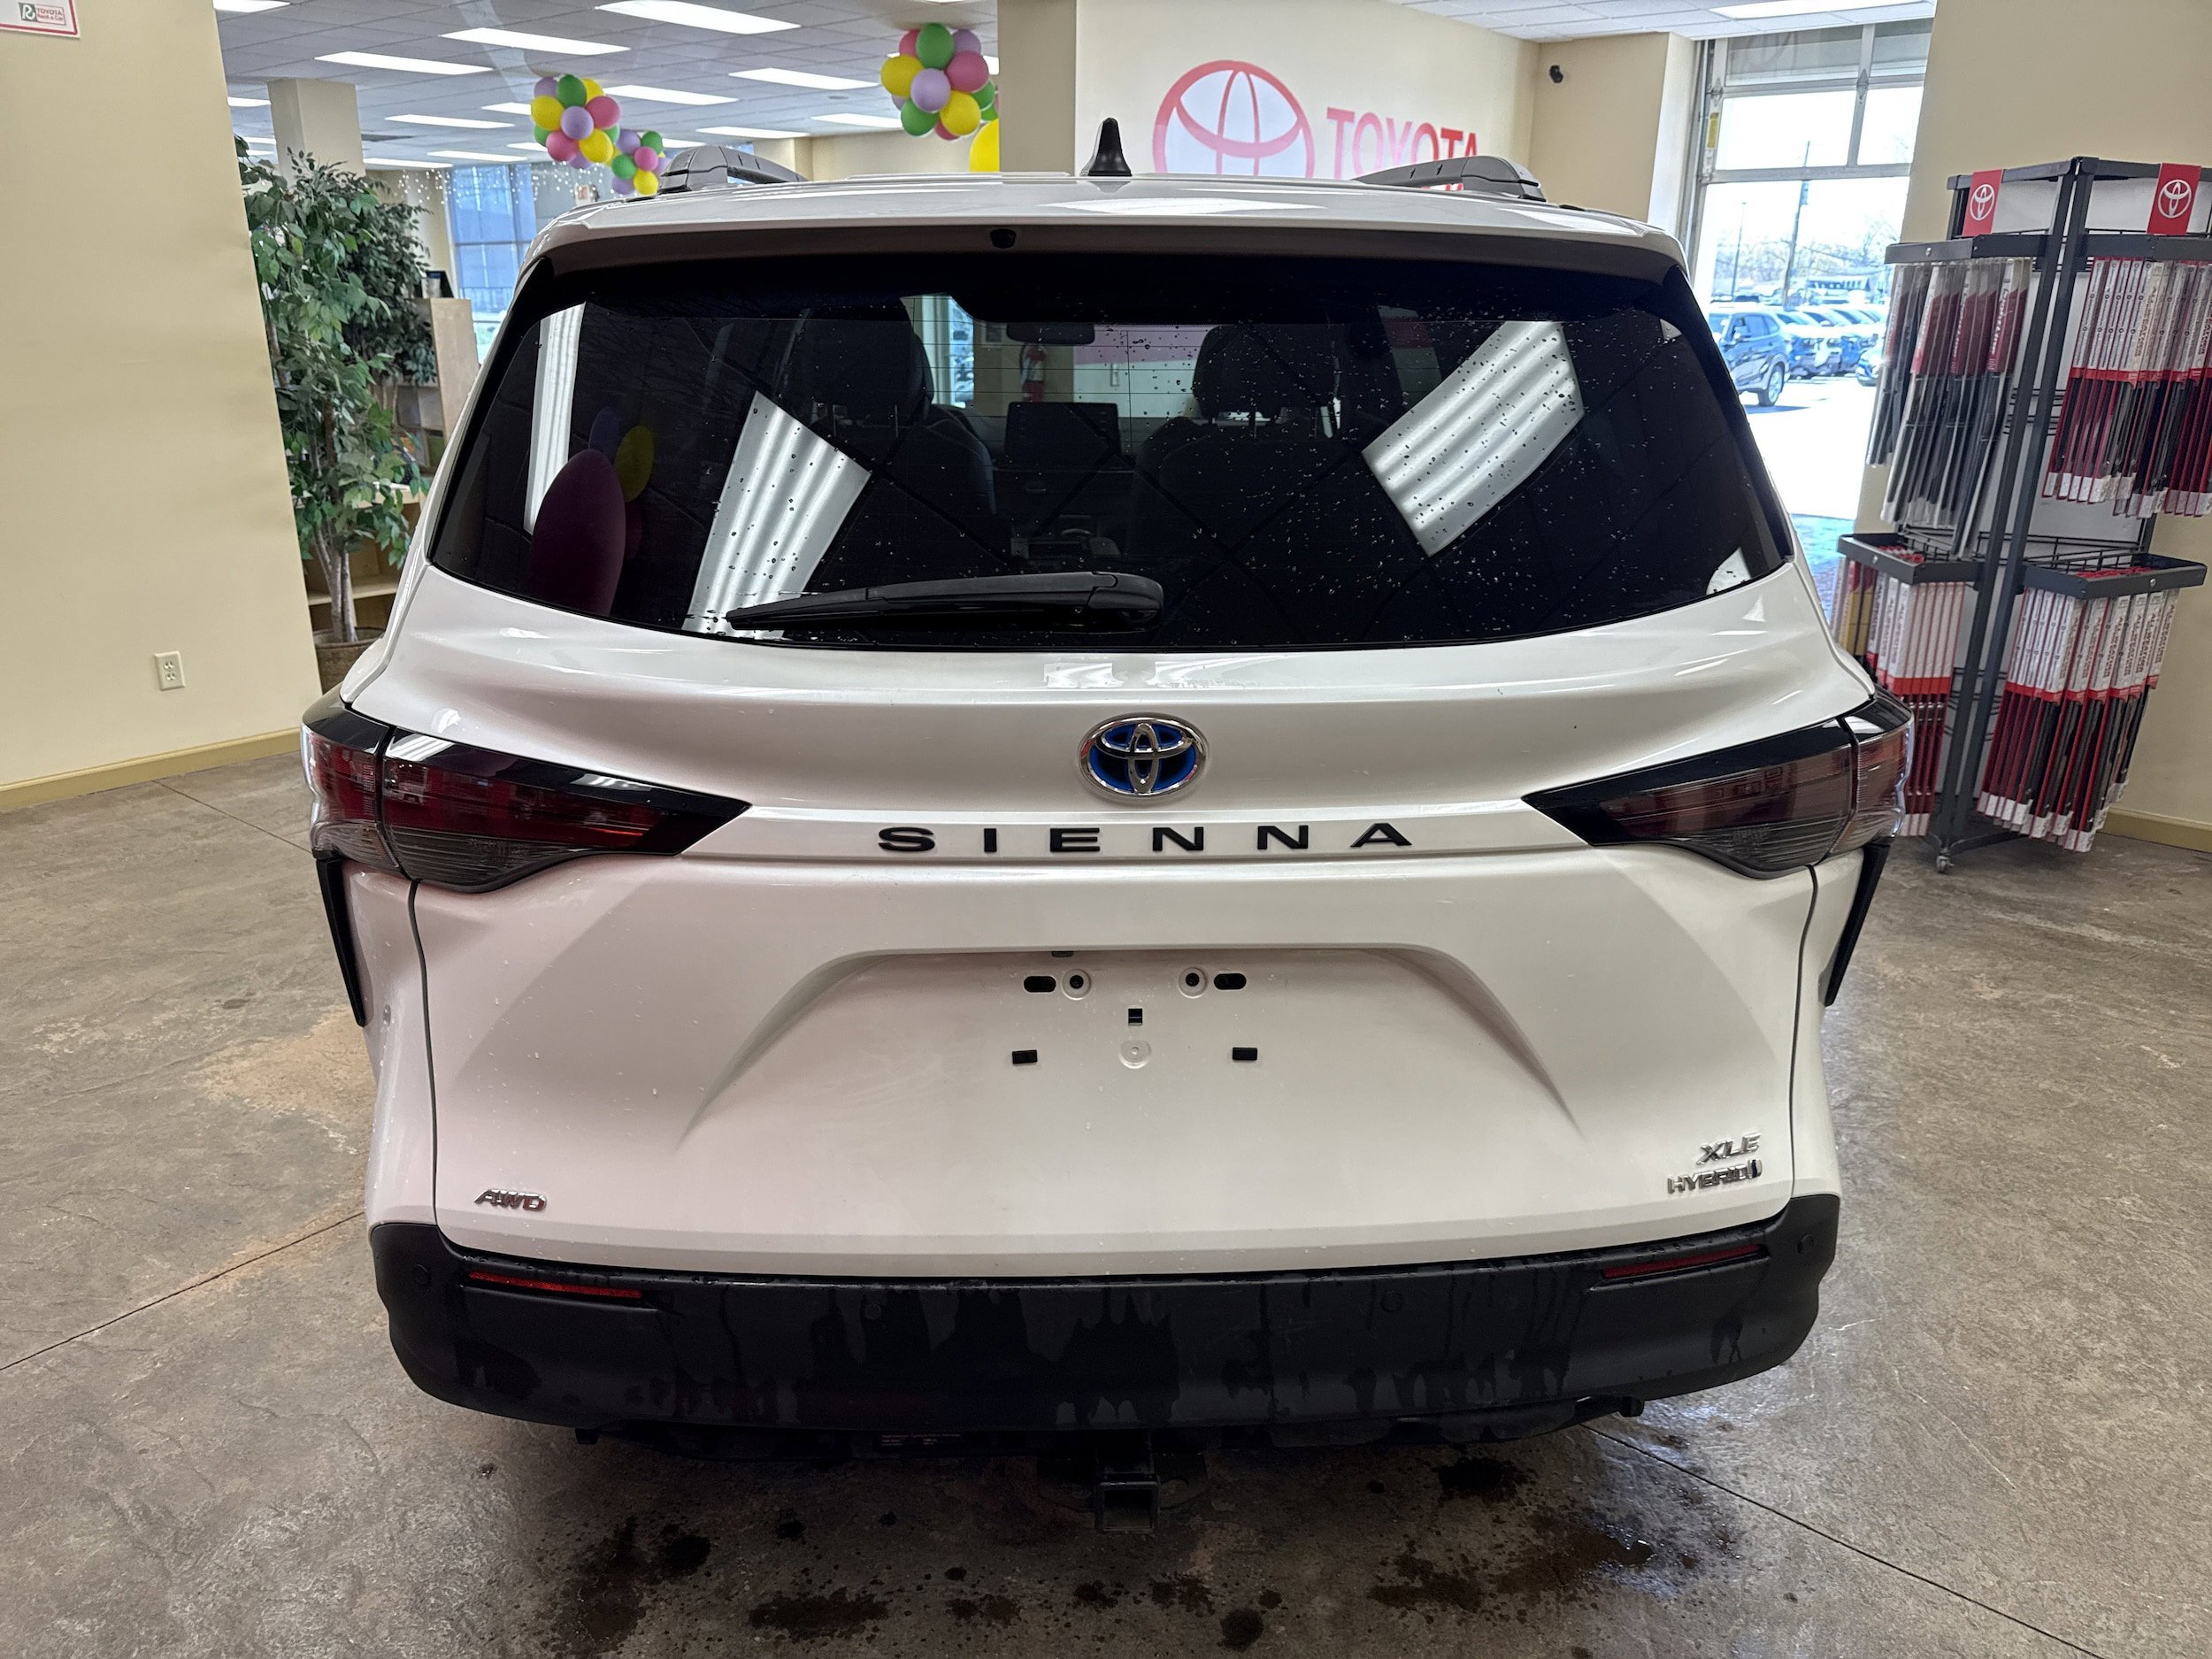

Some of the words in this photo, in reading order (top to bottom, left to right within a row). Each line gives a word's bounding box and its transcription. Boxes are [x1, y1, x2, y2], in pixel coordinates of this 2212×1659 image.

[1326, 107, 1477, 190] TOYOTA
[878, 822, 1414, 854] SIENNA
[1695, 1132, 1762, 1165] XLE
[1667, 1164, 1748, 1194] HYBRID
[473, 1187, 547, 1212] AWD
